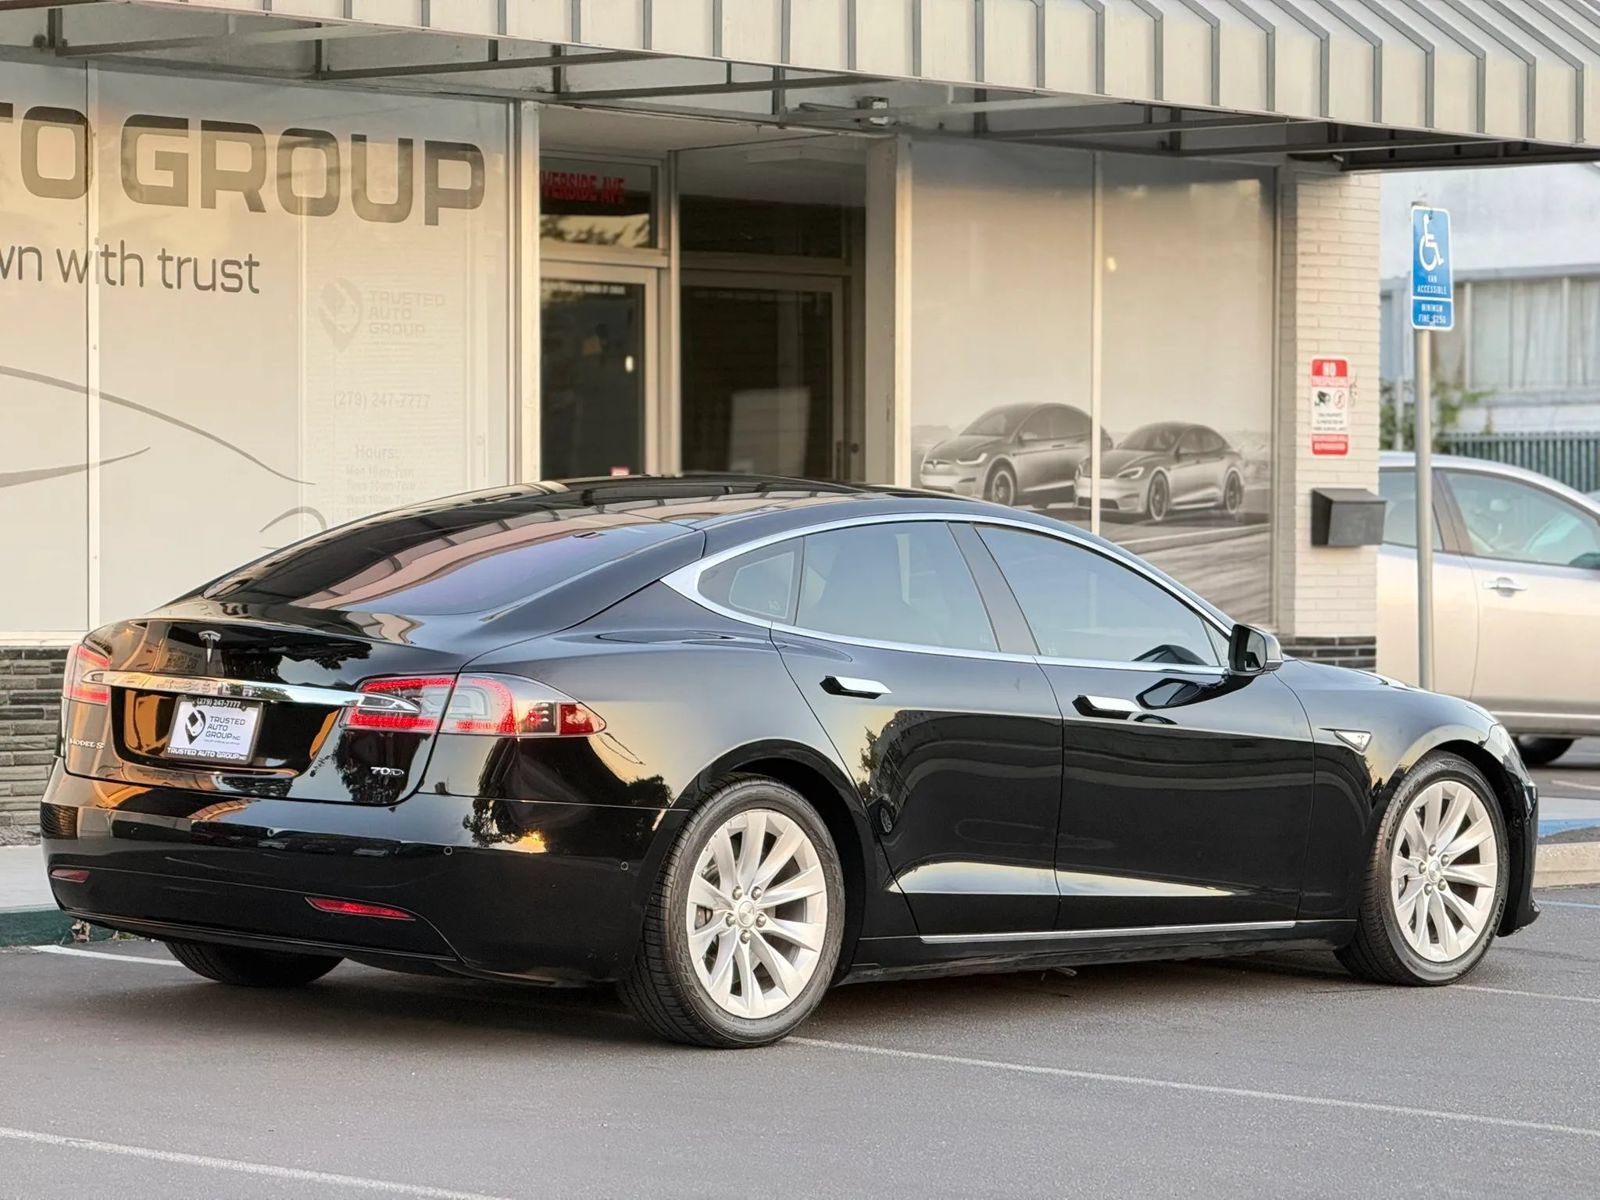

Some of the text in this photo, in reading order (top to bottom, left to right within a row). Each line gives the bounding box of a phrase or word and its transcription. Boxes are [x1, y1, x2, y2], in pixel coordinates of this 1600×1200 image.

[120, 113, 486, 226] GROUP
[56, 240, 144, 288] with
[157, 247, 260, 294] trust
[368, 290, 446, 306] TRUSTED
[368, 306, 412, 321] AUTO
[368, 322, 425, 338] GROUP
[334, 391, 431, 409] (279) 247-7777
[196, 697, 241, 708] (279) 247-7777
[210, 715, 245, 726] TRUSTED
[207, 723, 229, 732] AUTO
[205, 730, 232, 739] GROUP
[69, 737, 105, 750] MODEL S
[167, 747, 196, 756] TRUSTED
[198, 750, 215, 758] AUTO
[216, 752, 239, 760] GROUP
[370, 766, 405, 776] 70D
